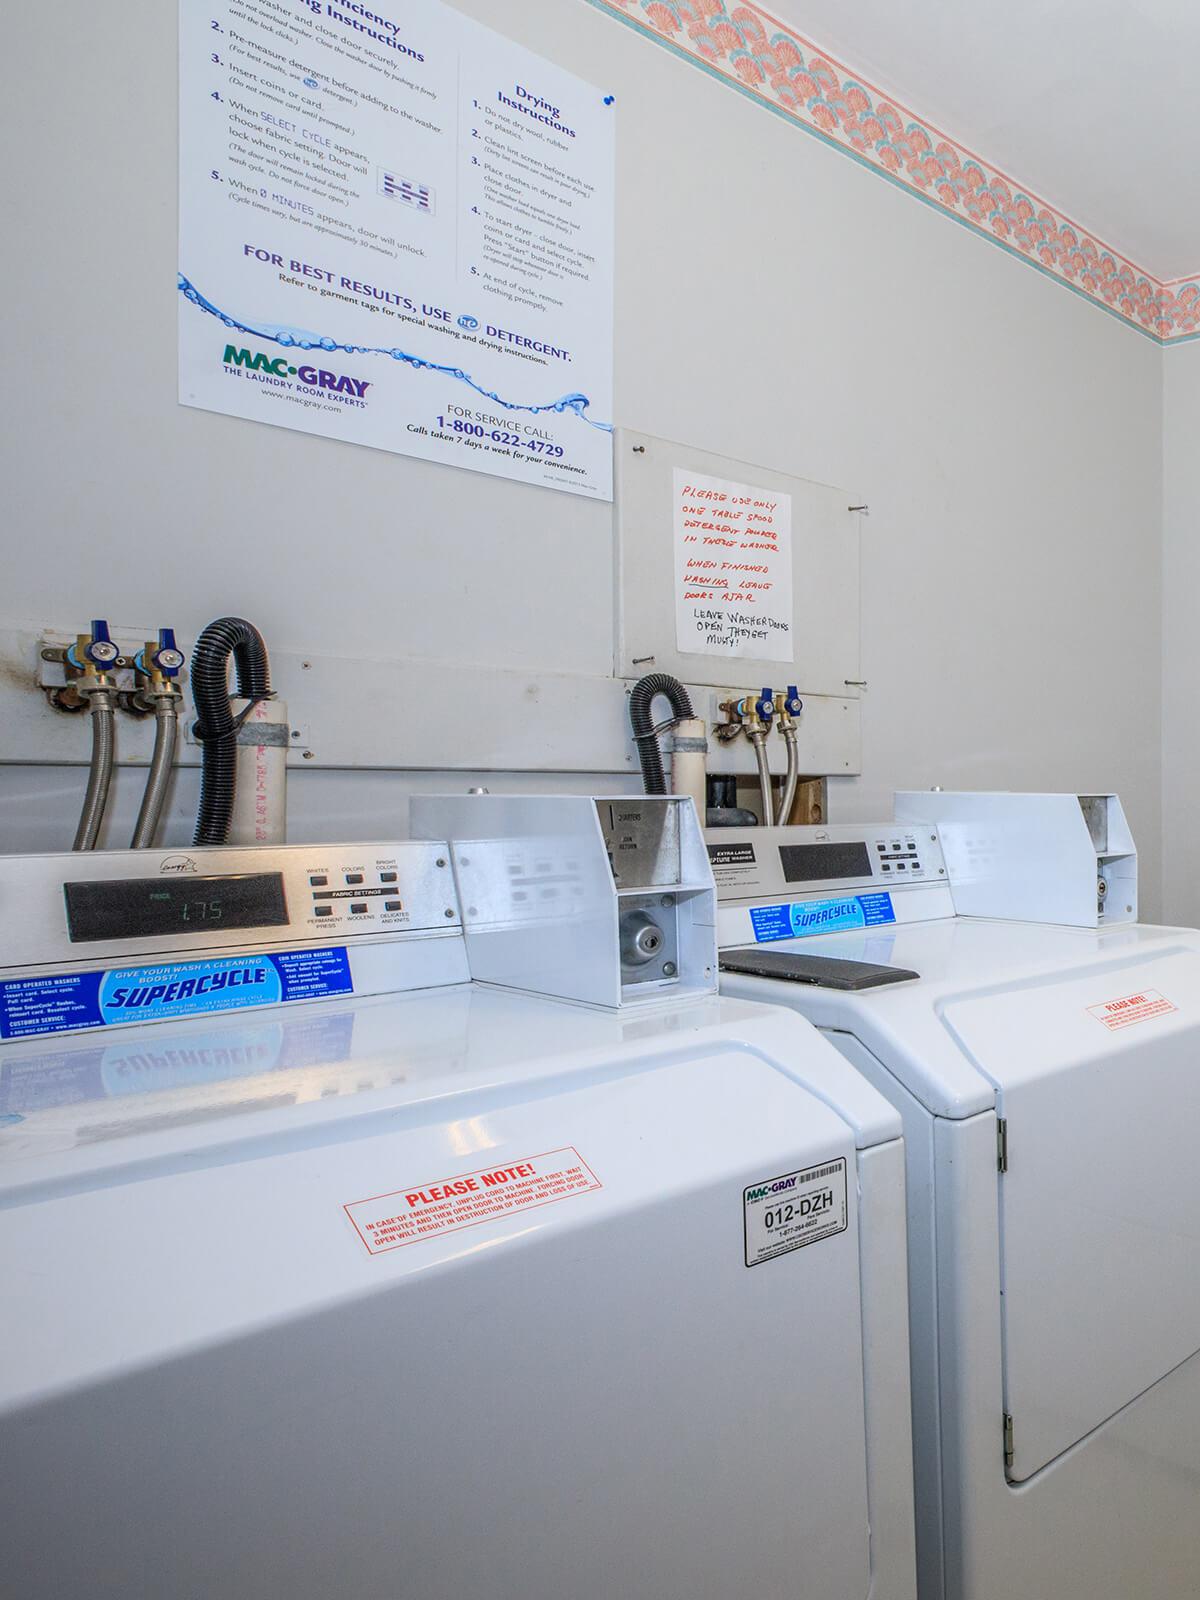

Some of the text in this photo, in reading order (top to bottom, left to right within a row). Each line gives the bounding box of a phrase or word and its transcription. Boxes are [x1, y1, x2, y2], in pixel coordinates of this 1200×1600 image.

[327, 4, 424, 62] Instructions
[211, 20, 441, 132] 2. Pre-measure detergent before adding to the washer.
[211, 53, 323, 111] 3. Insert coins or card.
[498, 91, 575, 137] Instructions
[516, 85, 560, 119] Drying
[210, 91, 370, 164] 4. When SELECT CYCLE appears,
[244, 244, 571, 362] FOR BEST RESULTS, USE DETERGENT.
[278, 272, 548, 365] Refer to garment tags for special washing and drying instructions.
[223, 365, 368, 408] THE LAUNDRY ROOM EXPERTS
[261, 389, 341, 413] www.macgray.com
[436, 415, 563, 457] 1-800-622-4729
[447, 404, 553, 441] FOR SERVICE CALL:
[406, 423, 428, 435] Calls
[430, 430, 454, 442] taken
[464, 438, 482, 449] days
[491, 447, 510, 456] week
[512, 450, 524, 458] for
[524, 455, 543, 463] your
[543, 460, 587, 475] convenience.
[682, 486, 727, 501] PLEASE
[754, 501, 777, 512] ONLY
[682, 506, 705, 515] ONE
[684, 575, 729, 587] WASHING
[687, 558, 768, 573] WHEN FINISHED
[694, 608, 723, 620] LEAVE
[727, 612, 768, 625] WASHER
[722, 593, 756, 602] AJAR
[697, 621, 768, 640] OPEN THEY GET
[794, 904, 856, 926] SUPERCYCLE
[106, 968, 266, 1008] SUPERCYCLE
[115, 971, 140, 979] GIVE
[173, 965, 202, 973] WASH
[213, 958, 262, 968] CLEANING
[139, 974, 178, 984] BOOST!
[1105, 995, 1146, 1012] PLEASE NOTE!
[375, 1217, 396, 1228] CASE
[394, 1214, 407, 1222] OF
[408, 1202, 455, 1218] EMERGENCY,
[455, 1193, 485, 1206] UNPLUG
[484, 1188, 504, 1197] CORD
[514, 1176, 545, 1189] MACHINE
[544, 1171, 566, 1180] FIRST.
[565, 1166, 581, 1174] WAIT
[379, 1221, 415, 1235] MINUTES
[416, 1216, 432, 1225] AND
[432, 1210, 452, 1220] THEN
[452, 1204, 473, 1215] OPEN
[472, 1199, 494, 1209] DOOR
[503, 1187, 534, 1200] MACHINE.
[536, 1179, 566, 1190] FORCING
[565, 1173, 584, 1182] DOOR
[405, 1163, 536, 1207] PLEASE NOTE!
[374, 1234, 396, 1246] OPEN
[396, 1229, 417, 1239] WILL
[417, 1220, 445, 1233] RESULT
[455, 1204, 504, 1222] DESTRUCTION
[503, 1200, 513, 1208] OF
[514, 1195, 534, 1205] DOOR
[534, 1191, 549, 1199] AND
[548, 1186, 567, 1195] LOSS
[575, 1179, 589, 1187] USE.
[765, 1191, 833, 1229] 012-DZH
